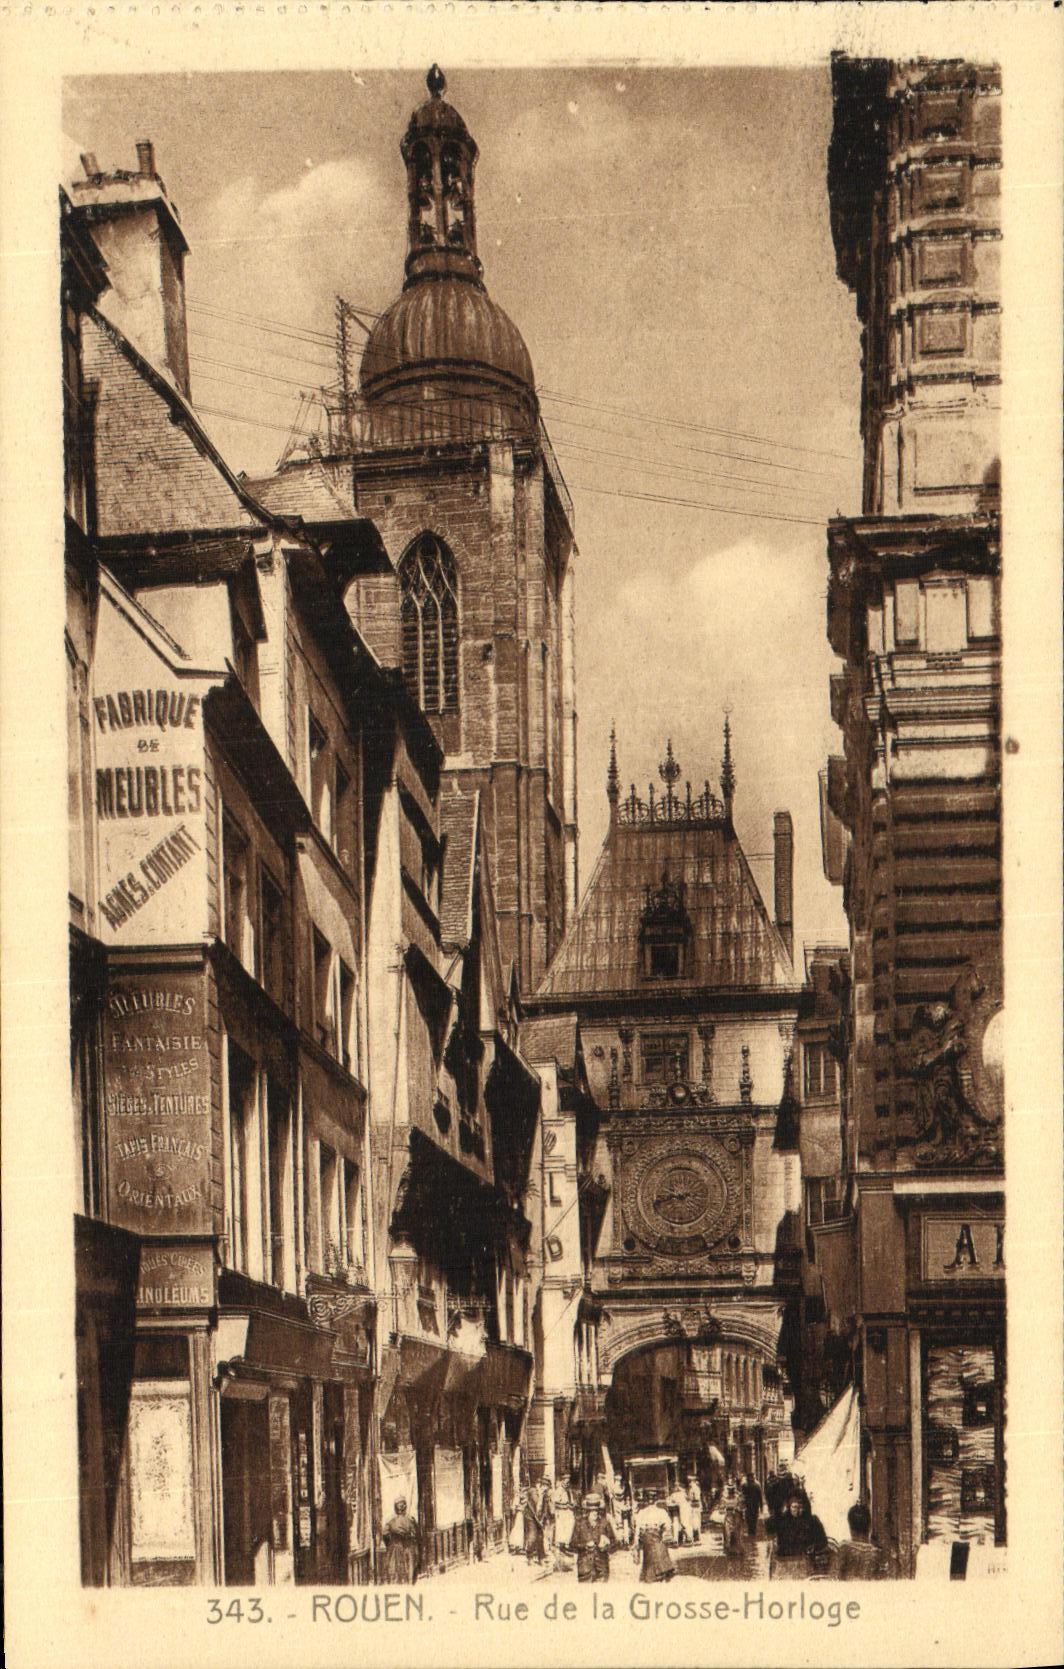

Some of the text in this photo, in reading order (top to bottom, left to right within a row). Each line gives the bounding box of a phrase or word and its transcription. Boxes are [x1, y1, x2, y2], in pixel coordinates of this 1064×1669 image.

[93, 689, 199, 733] FABRIQUE
[137, 738, 160, 753] DE
[96, 764, 200, 819] MEUBLES
[140, 824, 201, 890] CONTANT
[111, 1031, 203, 1053] FANTAISIE
[153, 1094, 210, 1116] TENTURES
[118, 1181, 203, 1209] ORIENTAUX
